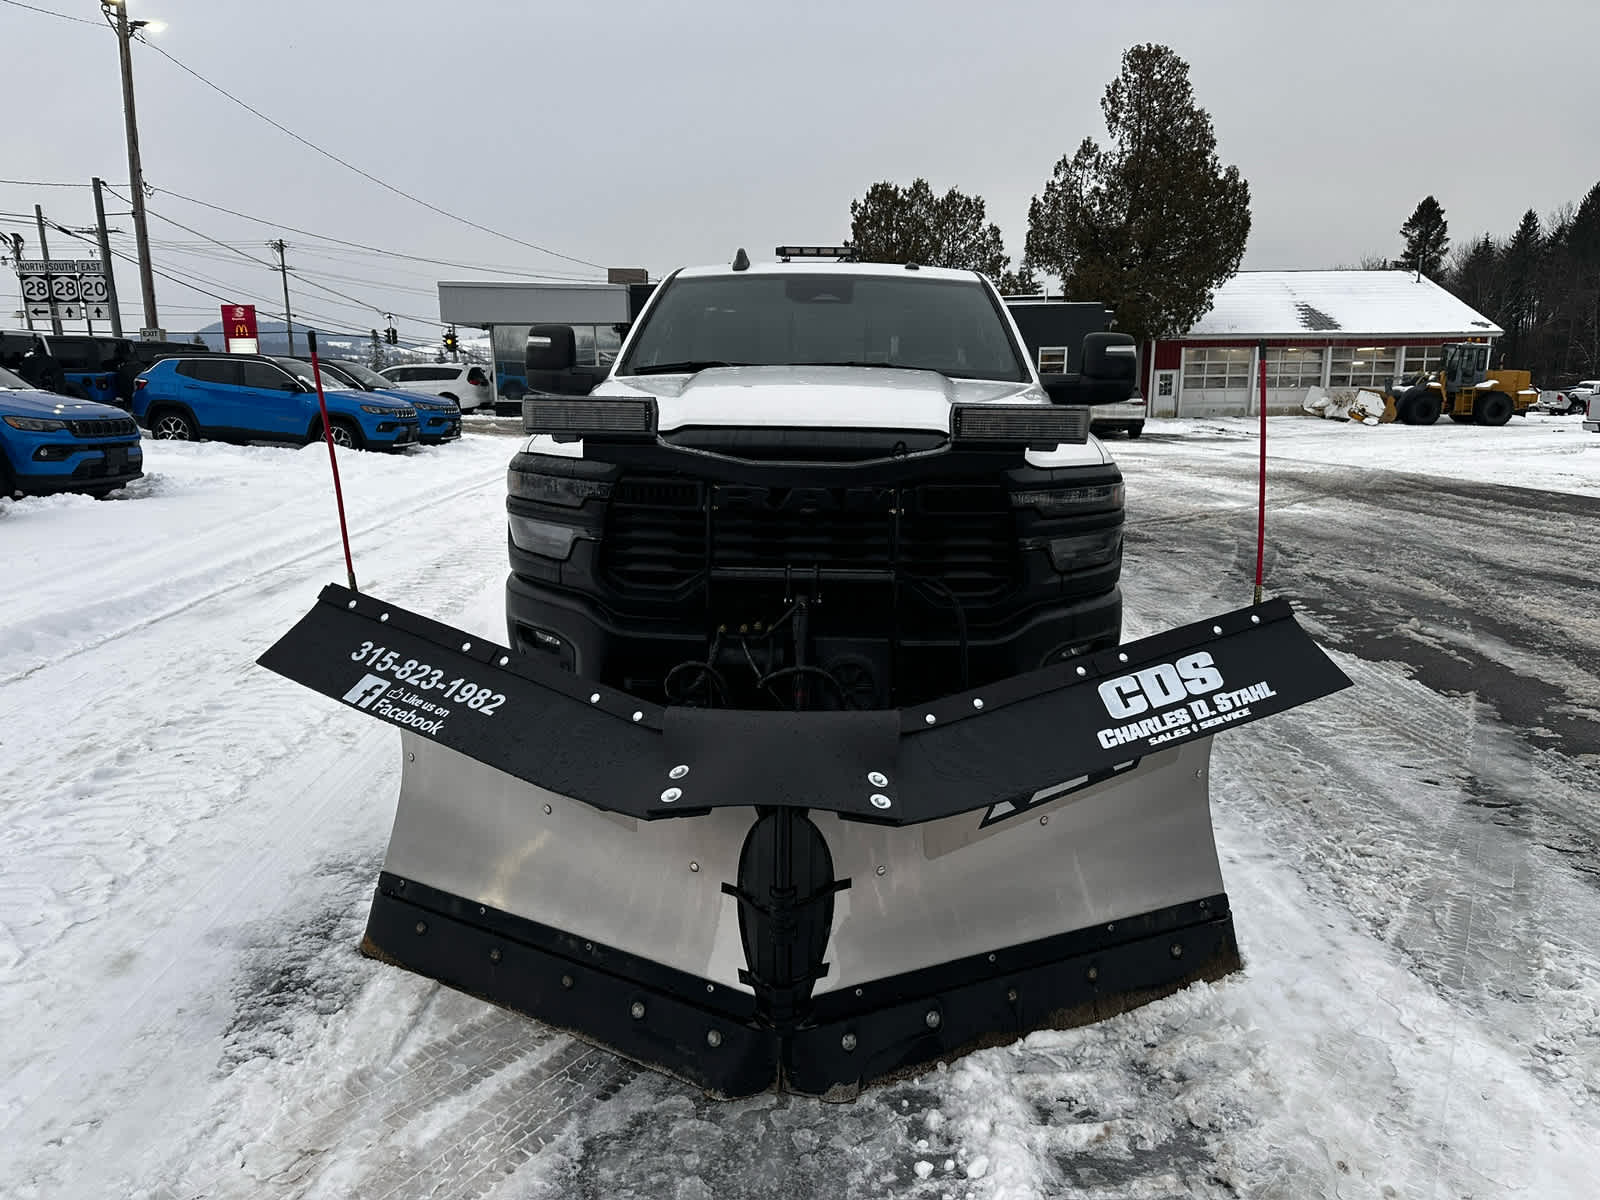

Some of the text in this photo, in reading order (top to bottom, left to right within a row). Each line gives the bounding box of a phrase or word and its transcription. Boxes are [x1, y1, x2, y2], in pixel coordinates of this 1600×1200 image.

[20, 262, 44, 271] NORTH
[48, 262, 74, 271] SOUTH
[81, 262, 101, 271] EAST
[25, 281, 47, 296] 28
[54, 281, 76, 296] 28
[82, 281, 106, 296] 20
[351, 640, 507, 716] 315-823-1982
[1097, 651, 1224, 720] CDS
[401, 691, 450, 718] Like us on
[371, 698, 445, 736] Facebook
[1096, 681, 1277, 750] CHARLES D. STAHL
[1148, 726, 1191, 746] SALES
[1200, 707, 1252, 730] SERVICE
